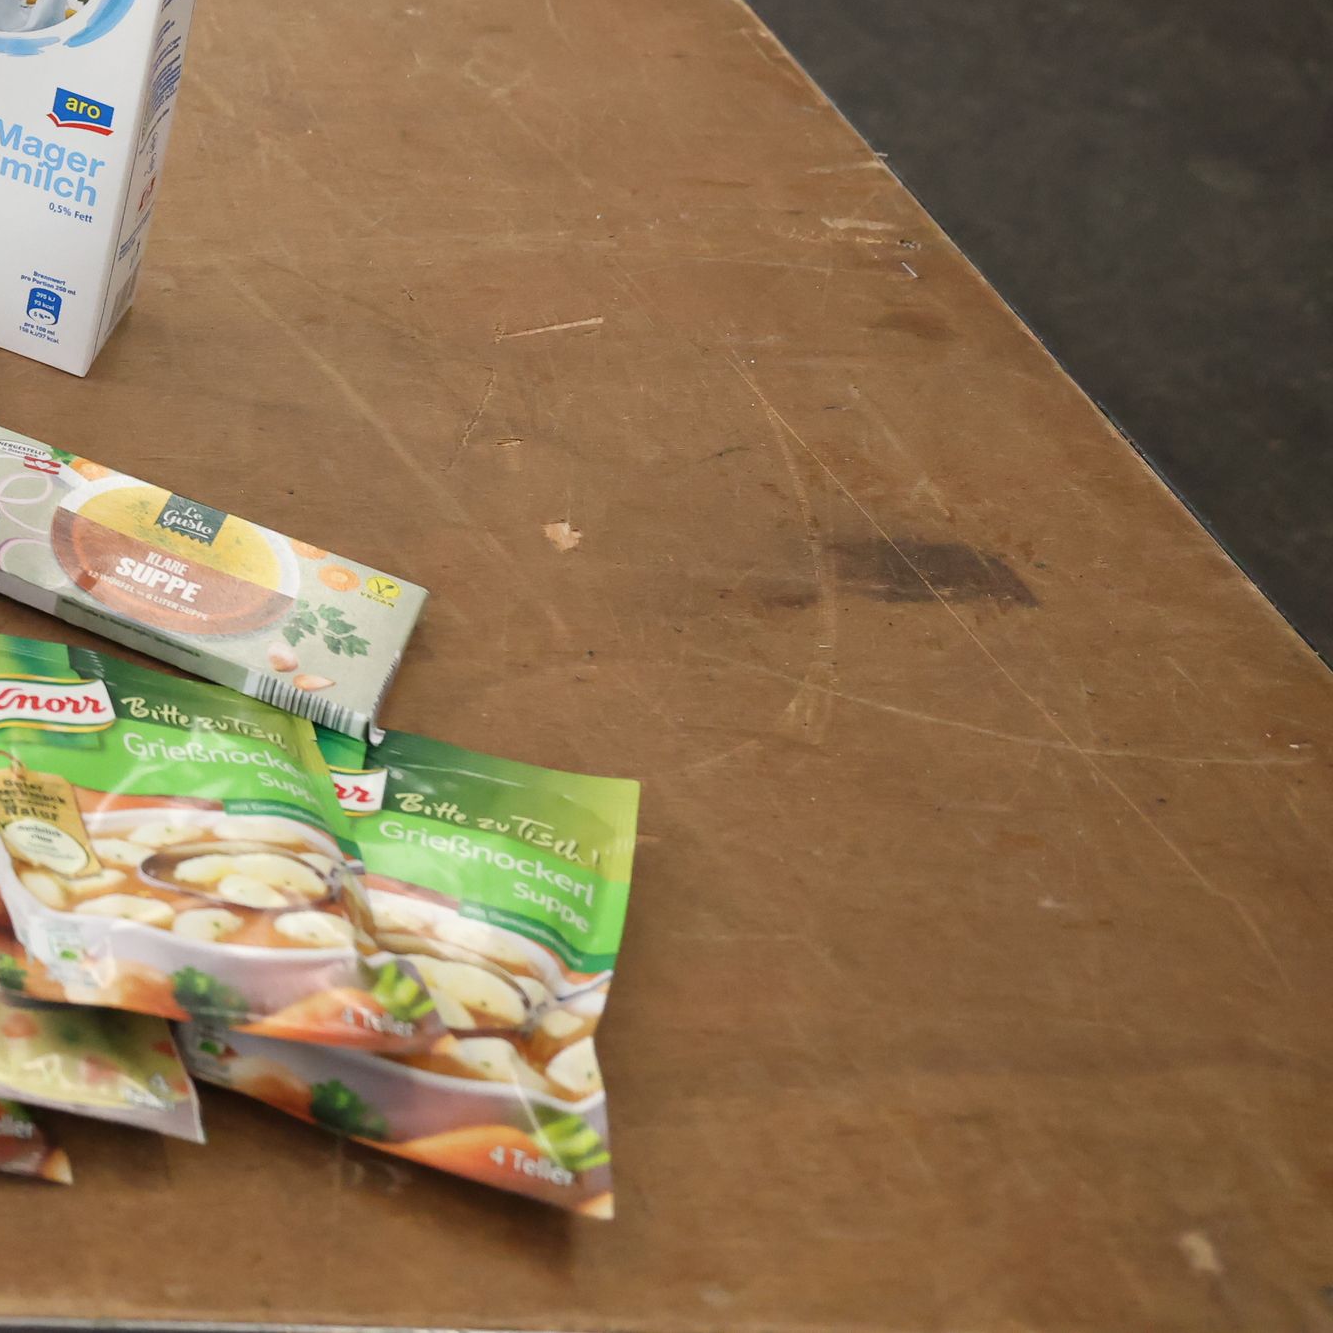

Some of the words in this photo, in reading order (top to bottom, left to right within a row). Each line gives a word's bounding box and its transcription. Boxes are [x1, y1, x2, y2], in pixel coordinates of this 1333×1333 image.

[65, 97, 101, 119] aro
[0, 153, 98, 207] milch
[48, 201, 72, 217] 0,5%
[74, 208, 93, 223] Fett
[163, 509, 213, 535] Gusto
[183, 506, 204, 520] Le
[115, 556, 203, 603] SUPPE
[145, 551, 190, 576] KLARE
[153, 594, 179, 610] LITER
[177, 603, 210, 622] SUPPE
[121, 697, 191, 728] Bitte
[197, 715, 229, 731] zu
[123, 732, 313, 781] Grießnocker
[258, 771, 318, 804] Supp
[395, 792, 470, 824] Bitte
[477, 816, 511, 834] zu
[379, 819, 596, 907] Grießnockerl
[513, 881, 590, 934] Suppe
[342, 1006, 357, 1024] 4
[359, 1008, 415, 1038] Teller
[489, 1144, 508, 1167] 4
[509, 1148, 575, 1188] Teller
